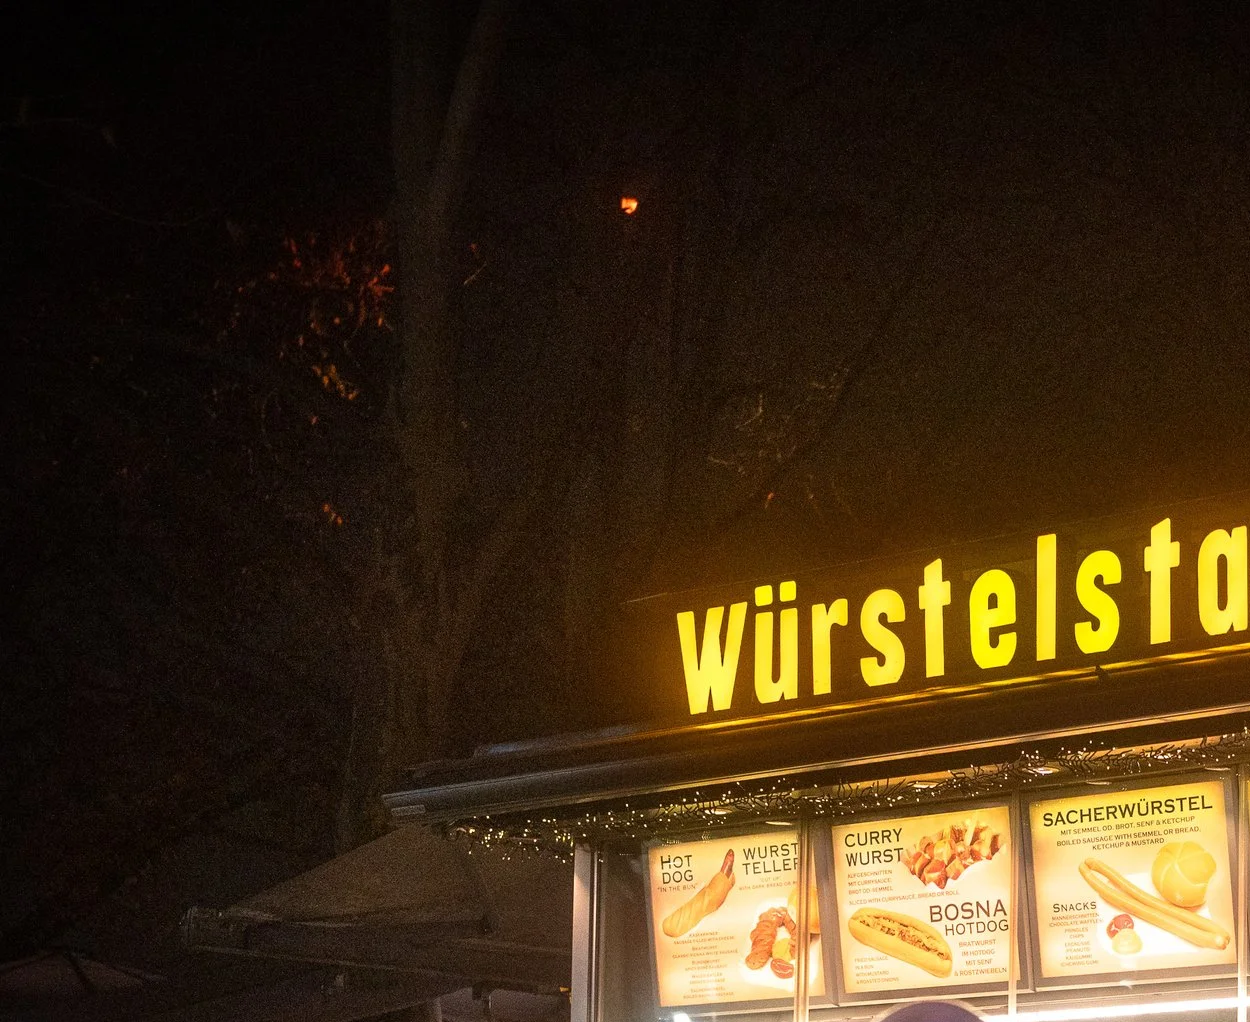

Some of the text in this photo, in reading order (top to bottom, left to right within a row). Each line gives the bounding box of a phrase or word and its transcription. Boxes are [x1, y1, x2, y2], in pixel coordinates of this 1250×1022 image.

[1042, 795, 1213, 827] SACHERWÜRSTEL
[1073, 827, 1101, 835] SEMMEL
[1137, 820, 1154, 828] SENF
[1162, 815, 1195, 825] KETCHUP
[844, 827, 903, 847] CURRY
[1056, 839, 1081, 847] BOILED
[1082, 835, 1114, 844] SAUSAGE
[1114, 832, 1132, 841] WITH
[1133, 830, 1163, 839] SEMMEL
[1092, 841, 1124, 851] KETCHUP
[1131, 838, 1164, 846] MUSTARD
[743, 842, 798, 860] WURST
[845, 847, 904, 867] WURST
[660, 854, 693, 870] HOT
[662, 870, 693, 885] DOG
[929, 899, 1008, 923] BOSNA
[945, 919, 1009, 936] HOTDOG
